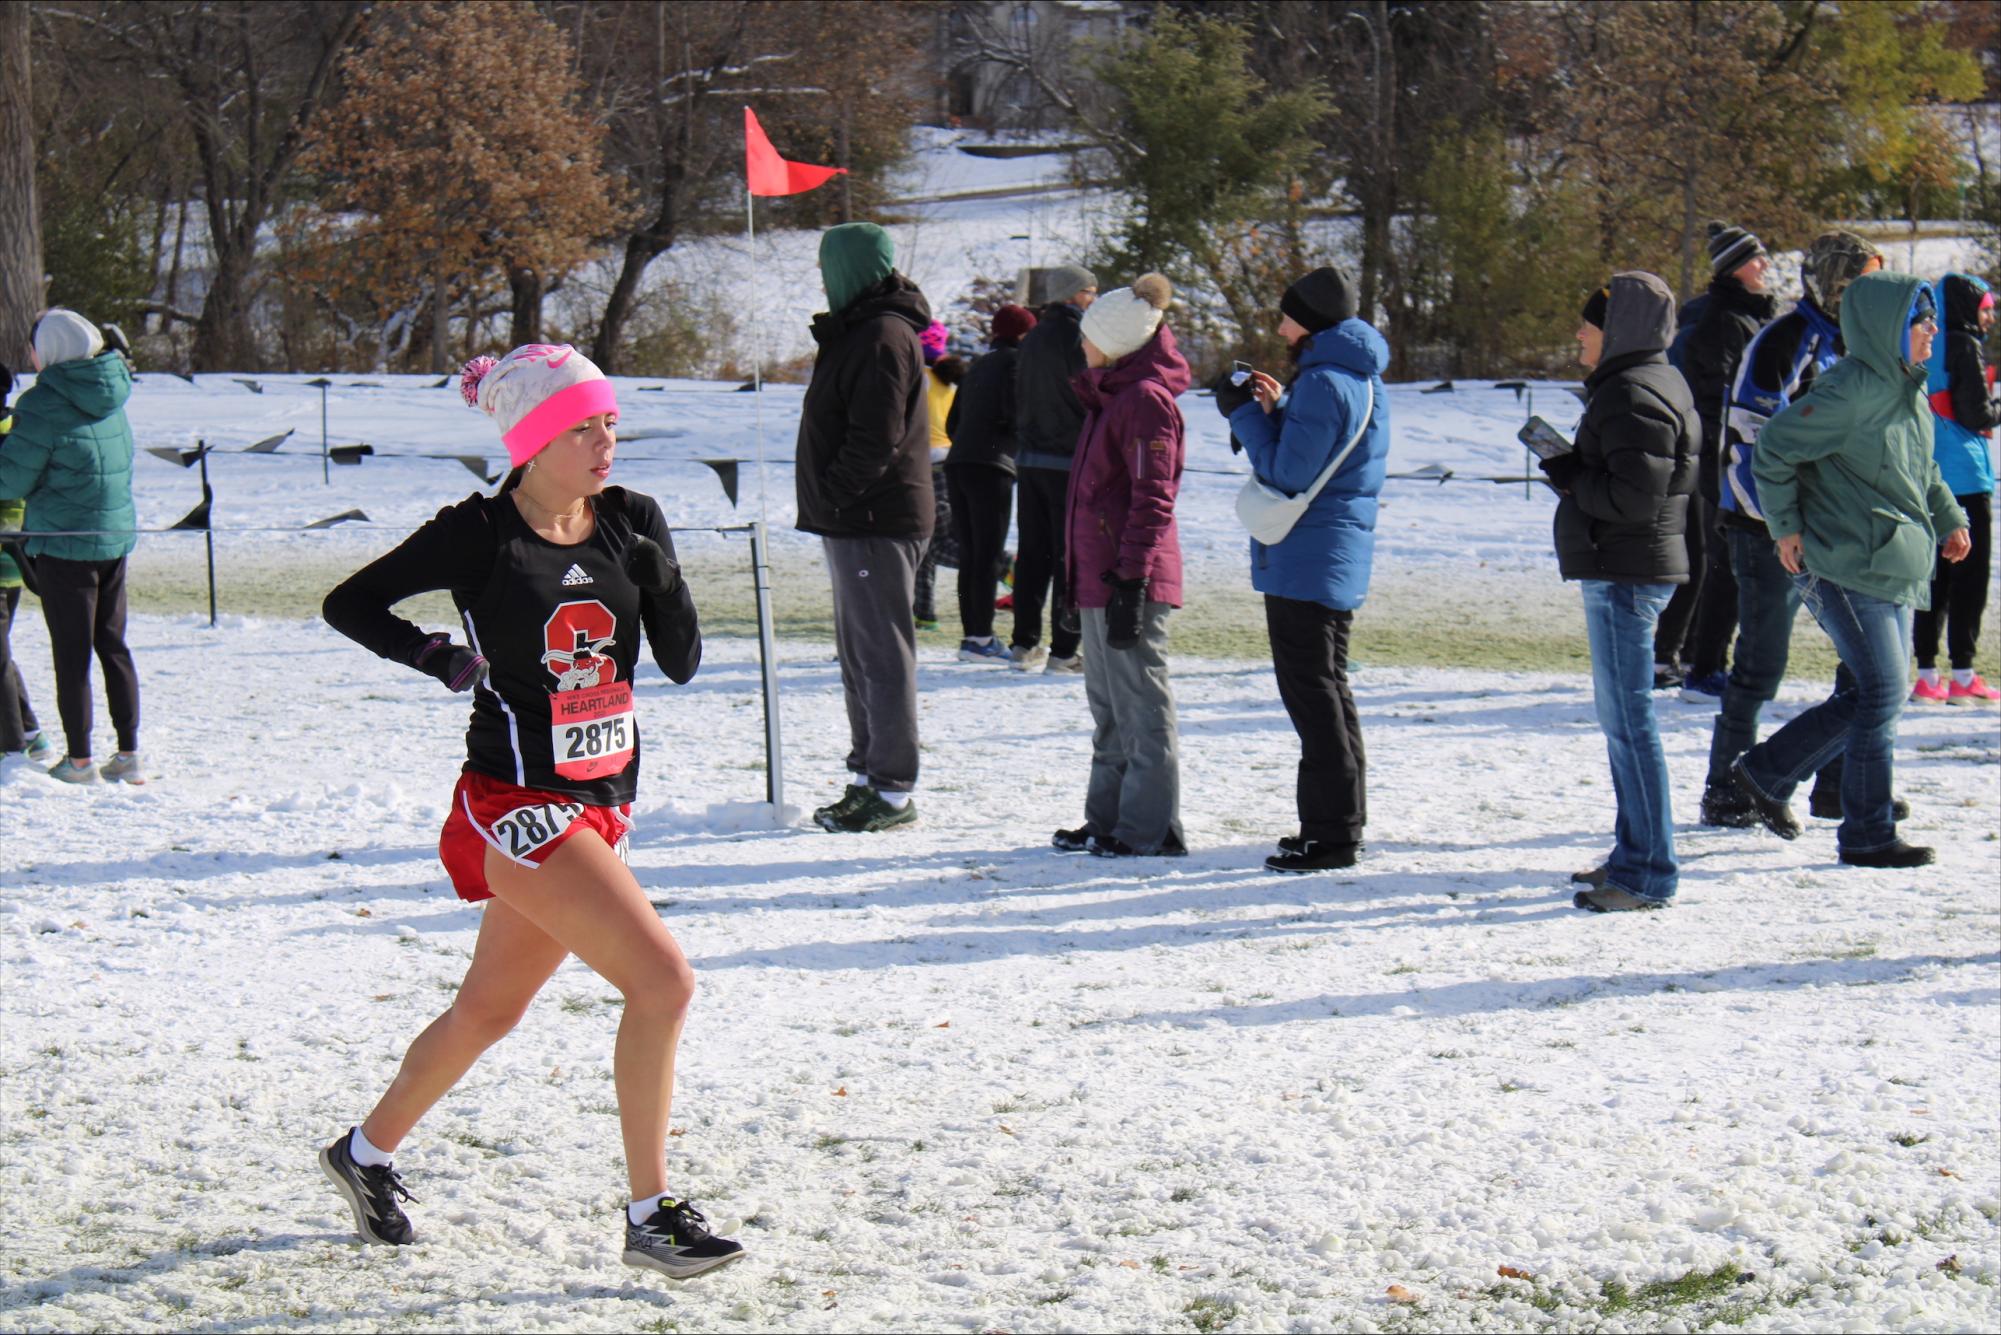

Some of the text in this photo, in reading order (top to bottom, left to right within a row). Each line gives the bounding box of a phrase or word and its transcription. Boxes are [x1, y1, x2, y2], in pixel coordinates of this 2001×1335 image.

[562, 575, 594, 586] adidas
[561, 692, 629, 715] HEARTLAND
[565, 717, 626, 759] 2875
